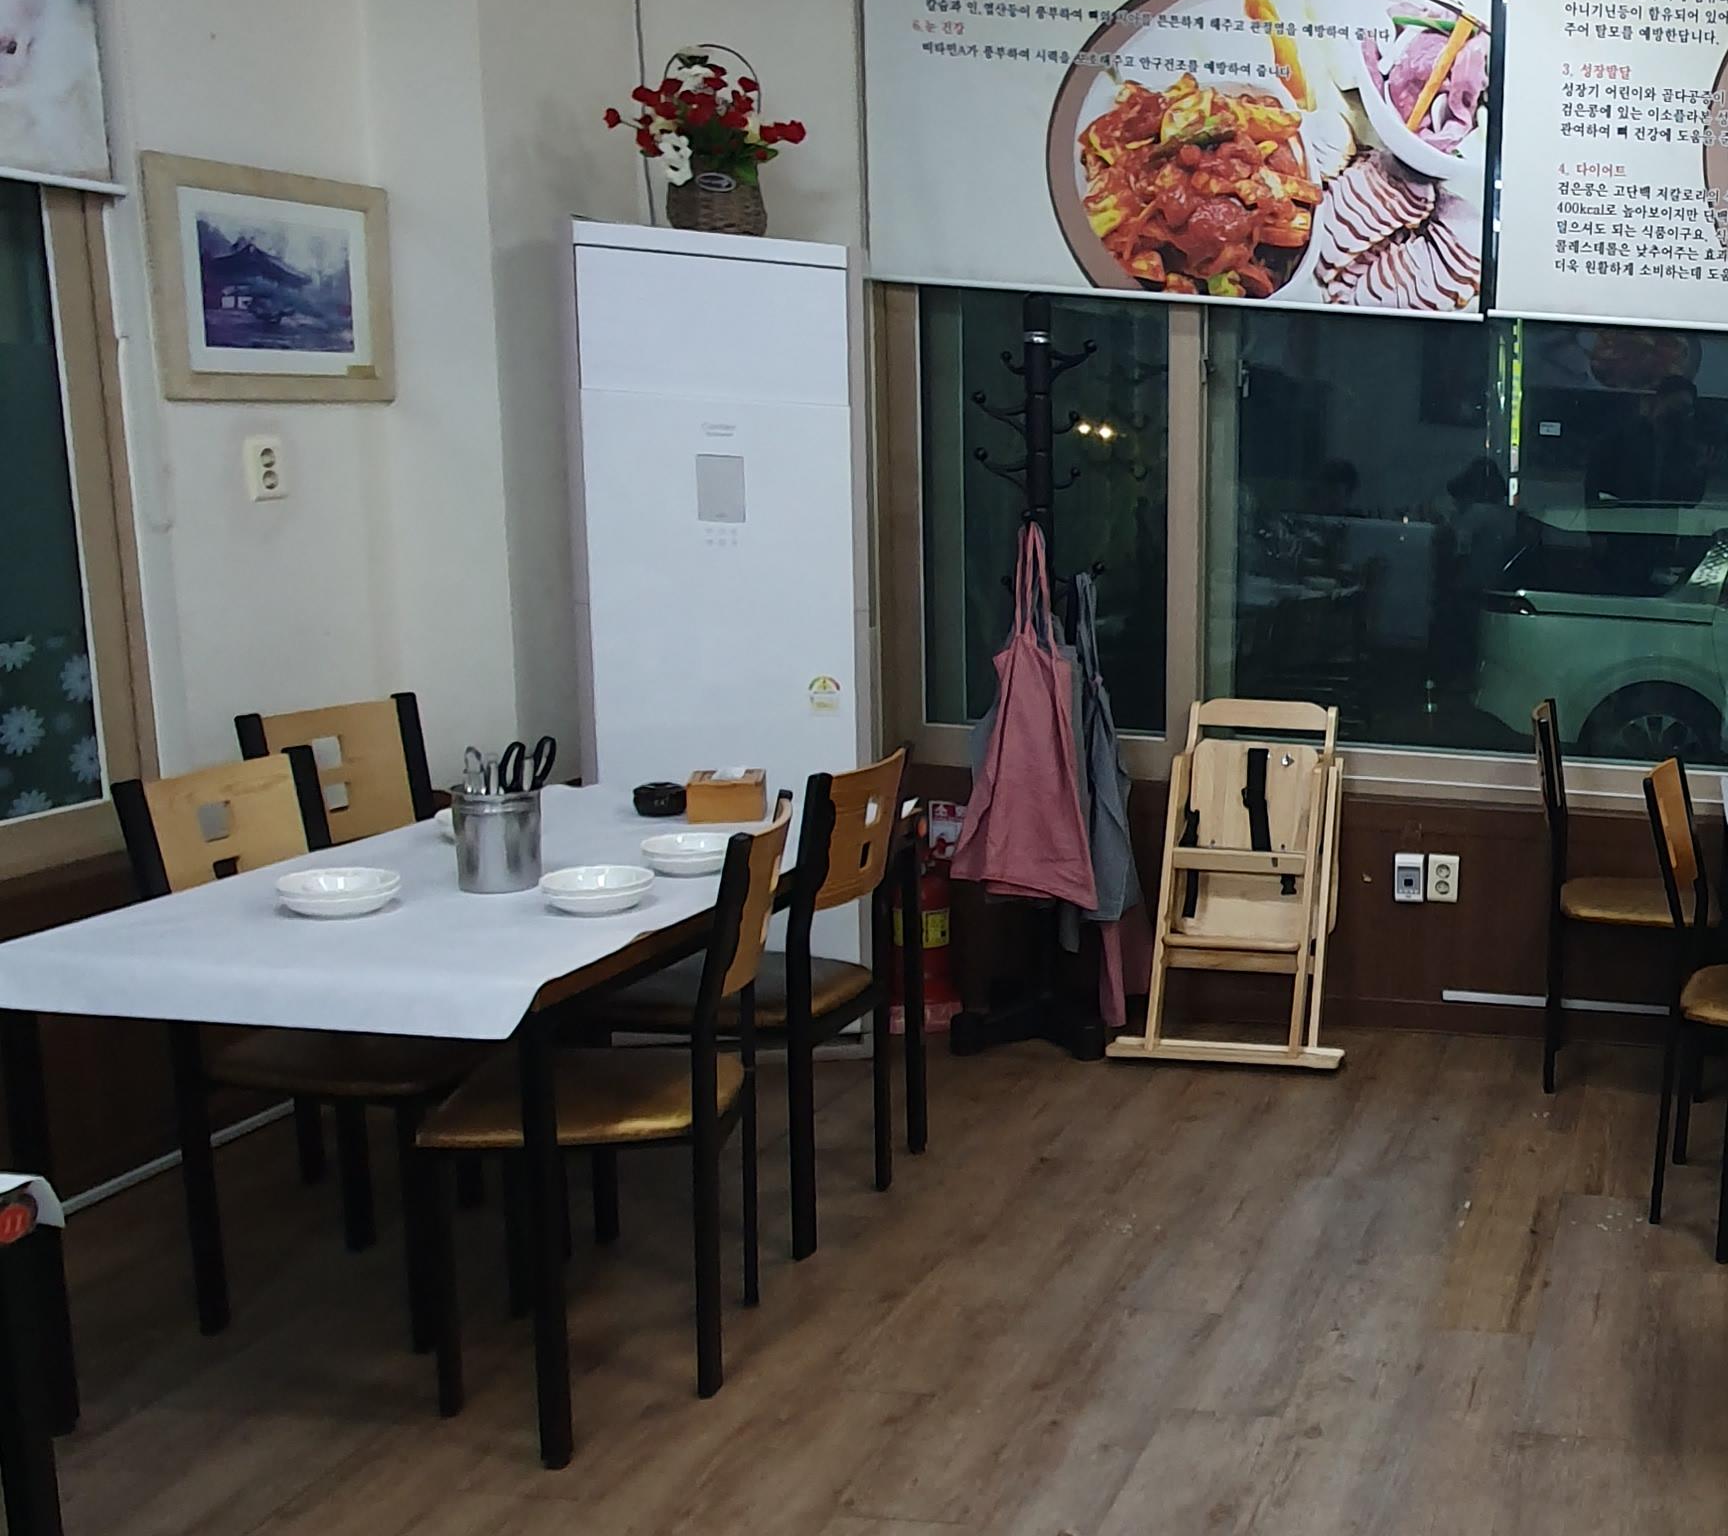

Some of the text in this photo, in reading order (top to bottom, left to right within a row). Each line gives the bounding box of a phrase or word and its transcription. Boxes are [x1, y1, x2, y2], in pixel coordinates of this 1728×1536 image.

[1564, 22, 1589, 37] 주어
[1562, 83, 1600, 99] 성장기
[1605, 85, 1656, 101] 어린이와
[1617, 106, 1642, 121] 있는
[1576, 163, 1627, 178] 다이어트
[1611, 223, 1637, 238] 되는
